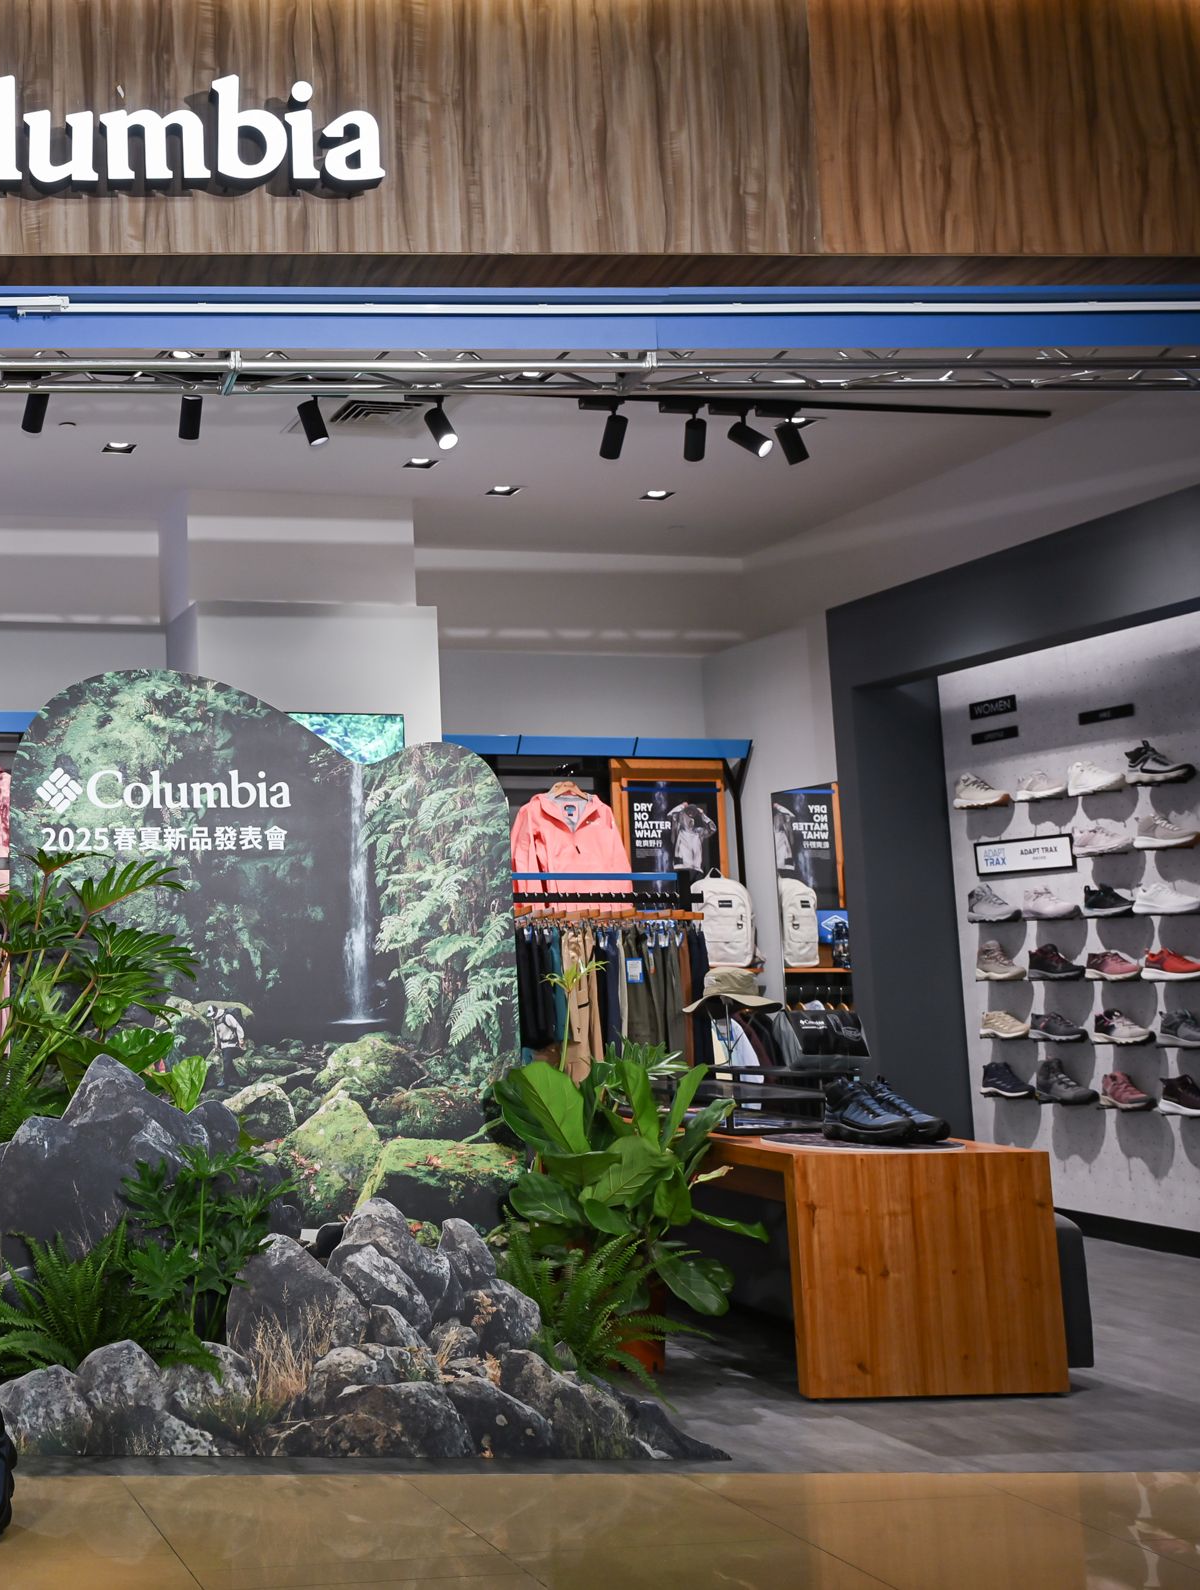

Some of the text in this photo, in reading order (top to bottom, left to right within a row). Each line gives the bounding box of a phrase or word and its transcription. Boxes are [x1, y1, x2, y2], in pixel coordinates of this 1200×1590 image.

[974, 699, 1011, 715] WOMEN
[86, 769, 291, 809] Columbia
[634, 803, 653, 811] DRY
[634, 812, 649, 820] NO
[634, 821, 671, 829] MATTER
[40, 825, 288, 851] 2025春夏新品發表會
[635, 829, 662, 838] WHAT
[984, 848, 1005, 858] ADAPT
[1020, 846, 1058, 856] ADAPT TRAX
[984, 857, 1007, 867] TRAX
